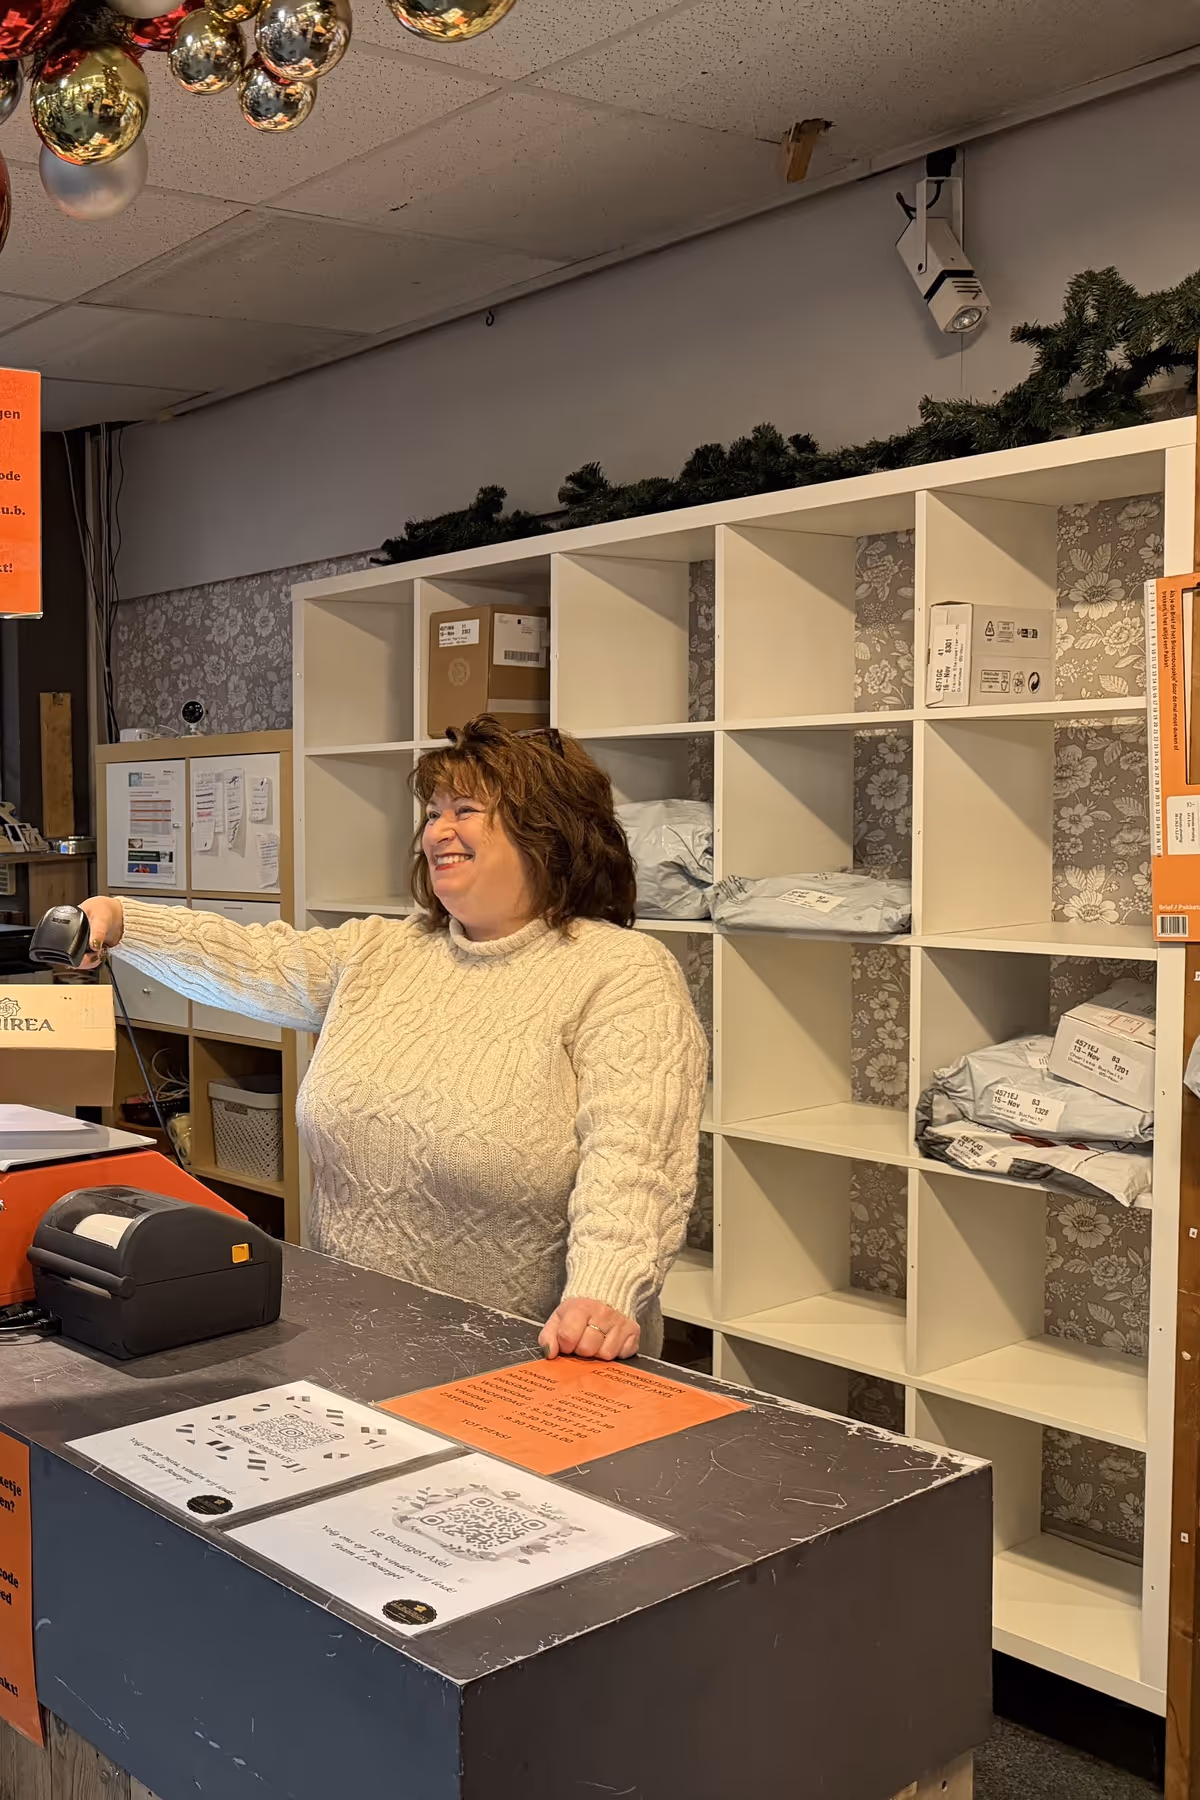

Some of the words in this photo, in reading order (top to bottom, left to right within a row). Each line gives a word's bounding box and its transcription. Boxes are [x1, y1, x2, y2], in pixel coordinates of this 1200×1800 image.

[938, 648, 944, 656] 41
[1075, 1038, 1100, 1054] 4571EJ
[1111, 1055, 1121, 1064] 83
[1114, 1064, 1130, 1076] 1201
[995, 1089, 1019, 1100] 4571EJ
[1031, 1098, 1041, 1107] 83
[493, 1376, 536, 1393] DINSDAG
[506, 1373, 556, 1392] MAANDAG
[519, 1369, 559, 1384] ZONDAG
[467, 1384, 526, 1407] DONDERDAG
[553, 1415, 574, 1424] TOT
[480, 1380, 534, 1401] WOENSDAG
[567, 1411, 588, 1419] TOT
[439, 1391, 487, 1411] ZATERDAG
[526, 1424, 547, 1433] TOT
[461, 1419, 482, 1428] TOT
[539, 1419, 561, 1429] TOT
[321, 1525, 340, 1537] Volg
[339, 1535, 355, 1544] ons
[383, 1556, 415, 1574] vinden
[416, 1572, 433, 1582] wij
[370, 1528, 386, 1538] Le
[384, 1535, 427, 1557] Bourget
[424, 1554, 453, 1569] Axel
[331, 1542, 356, 1556] Team
[366, 1561, 405, 1580] Bourget
